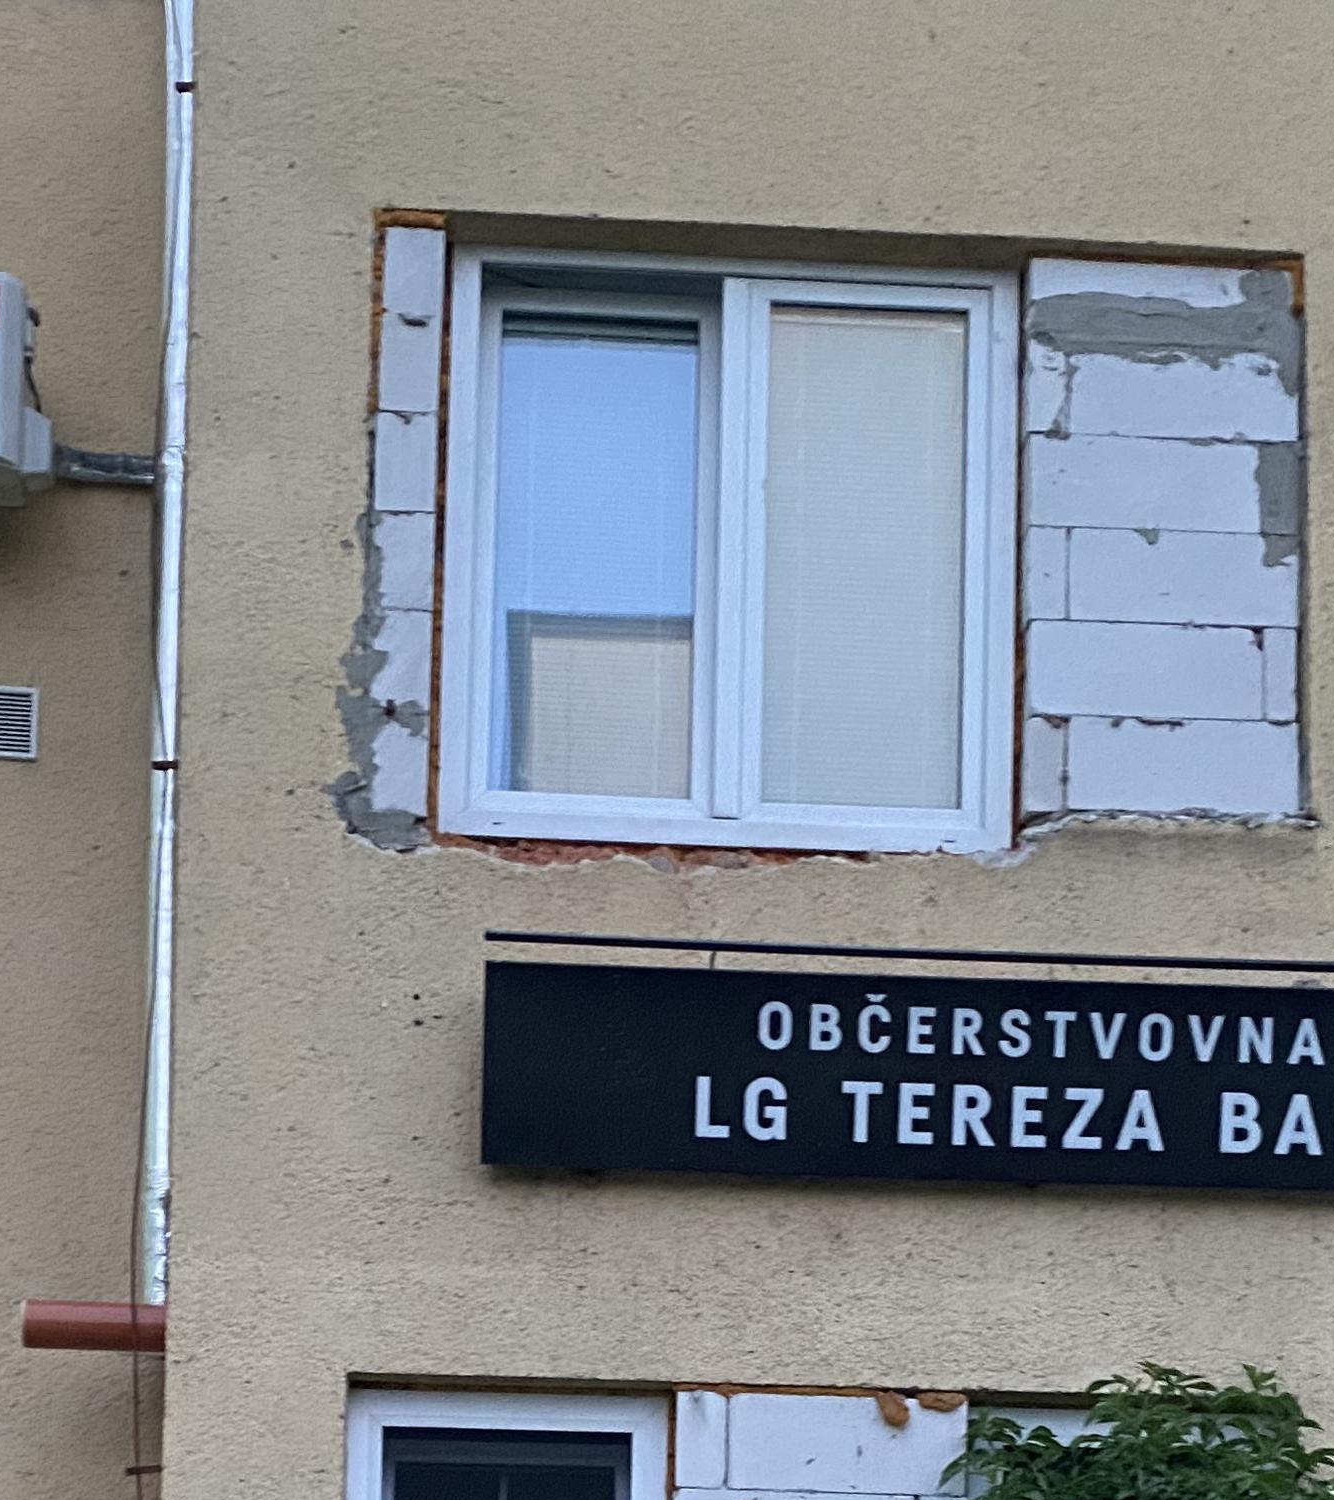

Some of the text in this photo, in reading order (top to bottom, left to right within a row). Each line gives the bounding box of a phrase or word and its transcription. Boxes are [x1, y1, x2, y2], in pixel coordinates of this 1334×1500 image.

[757, 993, 1327, 1066] OBČERSTVOVNA
[694, 1075, 788, 1142] LG
[840, 1080, 1166, 1152] TEREZA
